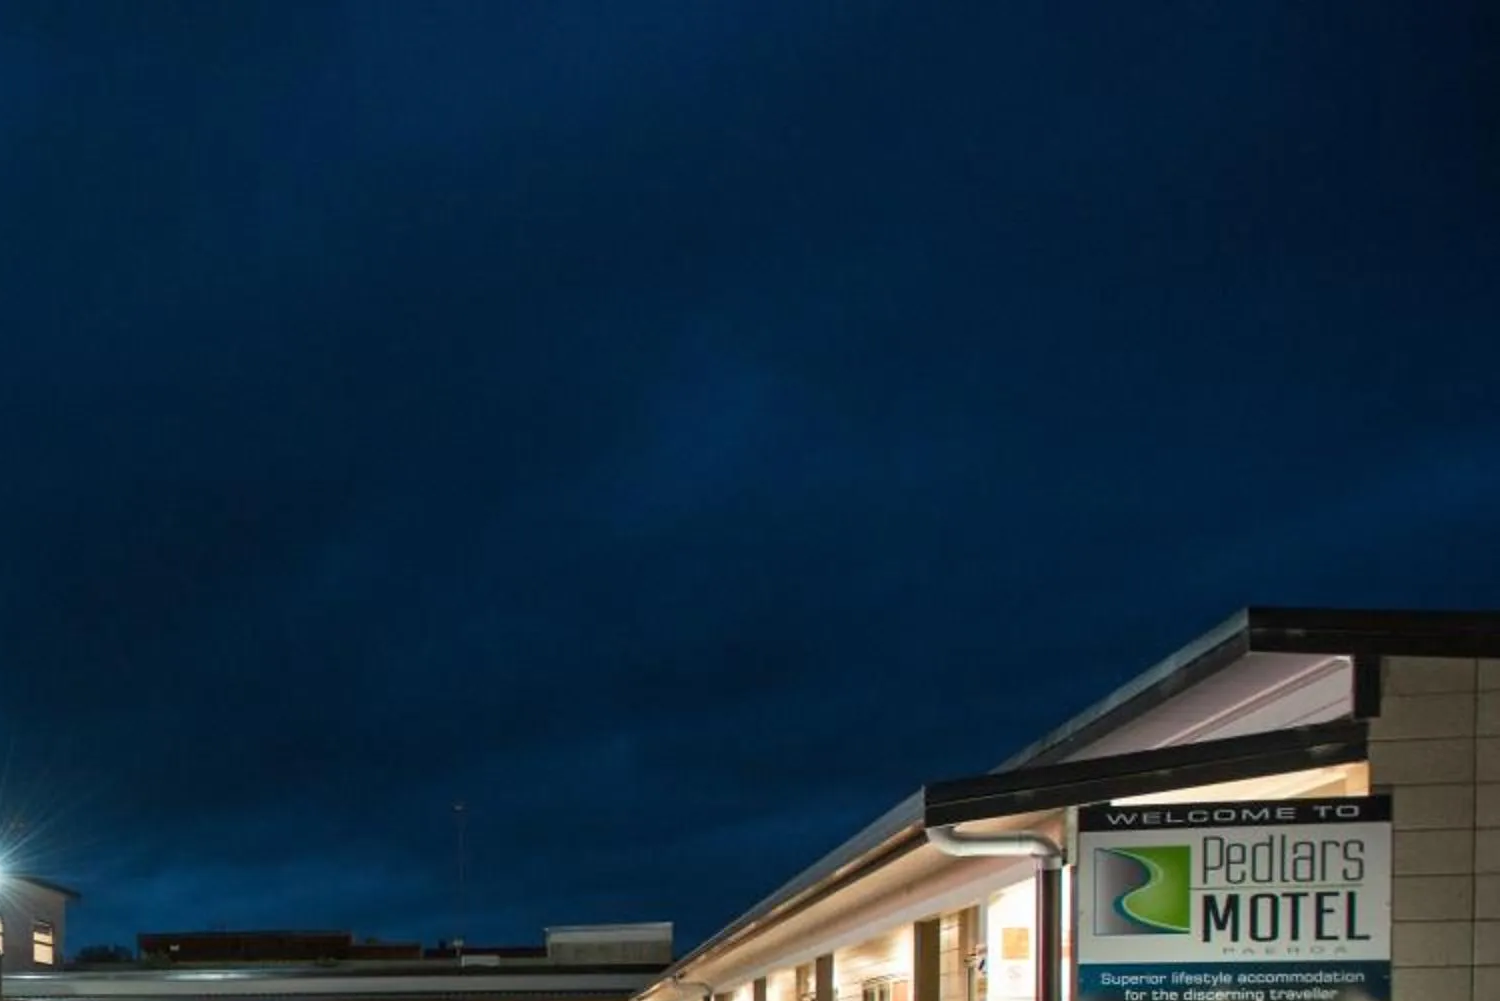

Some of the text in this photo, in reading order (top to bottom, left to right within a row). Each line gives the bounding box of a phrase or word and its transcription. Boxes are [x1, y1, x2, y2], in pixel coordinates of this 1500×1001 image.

[1107, 805, 1360, 826] WELCOME TO
[1203, 834, 1364, 884] Pedlars
[1203, 891, 1371, 942] MOTEL
[1101, 971, 1365, 986] Superior lifestyle accommodation
[1125, 987, 1338, 1001] for the discerning traveller
